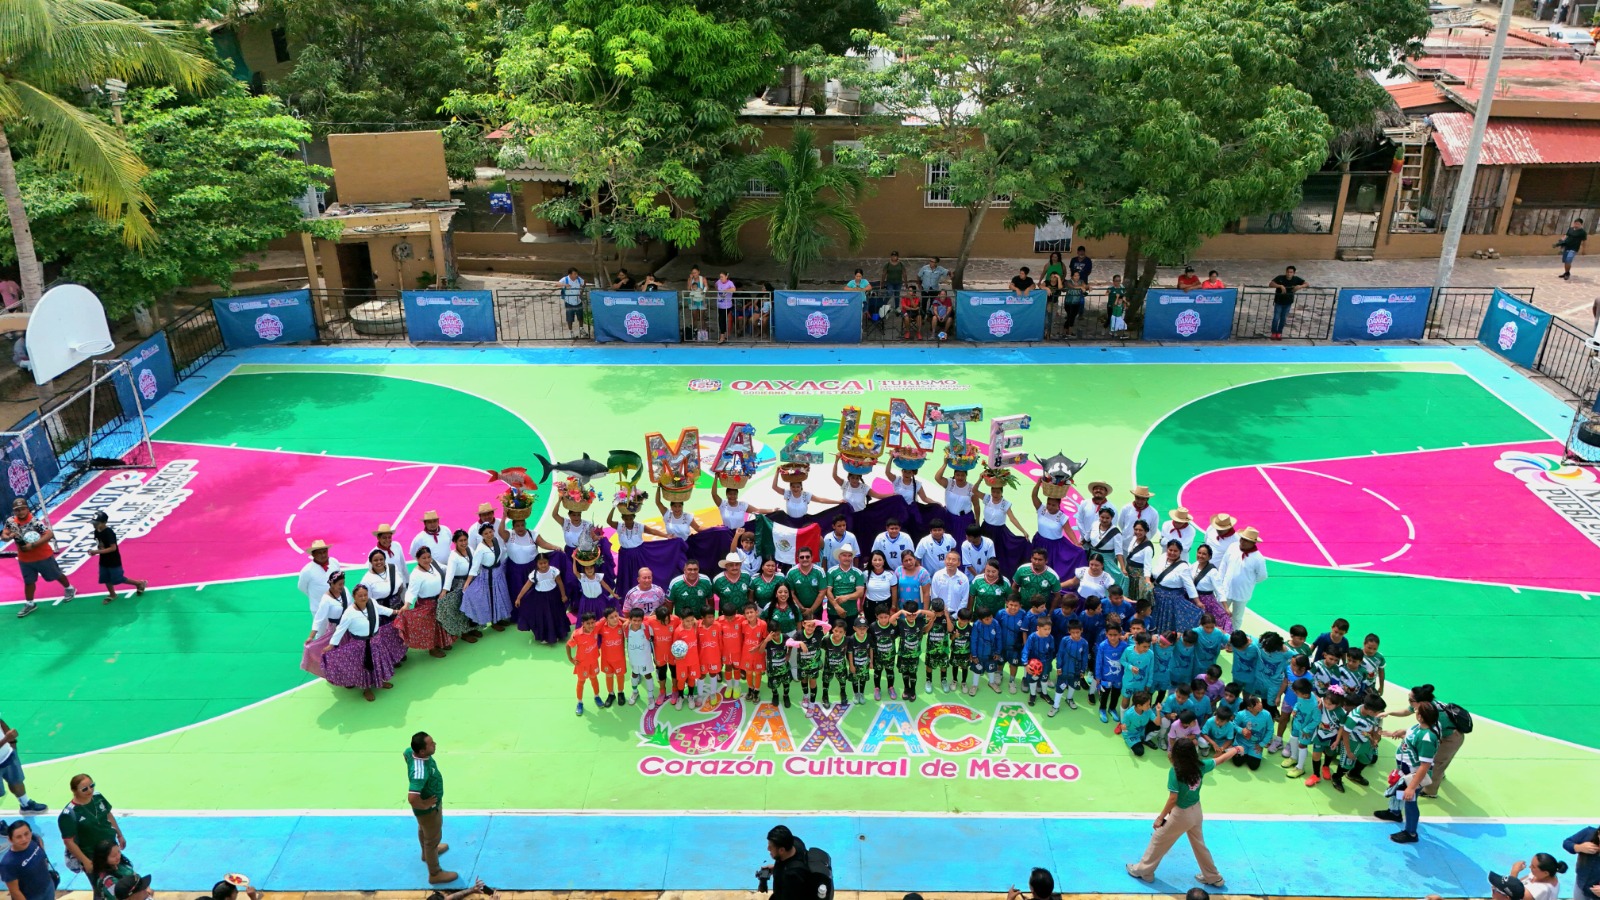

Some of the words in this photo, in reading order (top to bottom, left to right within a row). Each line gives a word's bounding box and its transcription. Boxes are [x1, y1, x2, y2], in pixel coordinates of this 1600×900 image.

[731, 380, 863, 390] OAXACA
[645, 398, 1031, 484] MAZUNTE
[63, 483, 141, 523] MAGIA
[52, 524, 85, 545] LA
[57, 518, 127, 574] ANCESTAL
[116, 502, 146, 512] DE
[889, 551, 898, 559] 12
[937, 553, 946, 562] 13
[638, 690, 1057, 756] OAXACA
[639, 755, 773, 775] Corazón
[785, 756, 907, 776] Cultural
[921, 758, 958, 778] de
[969, 758, 1080, 780] México
